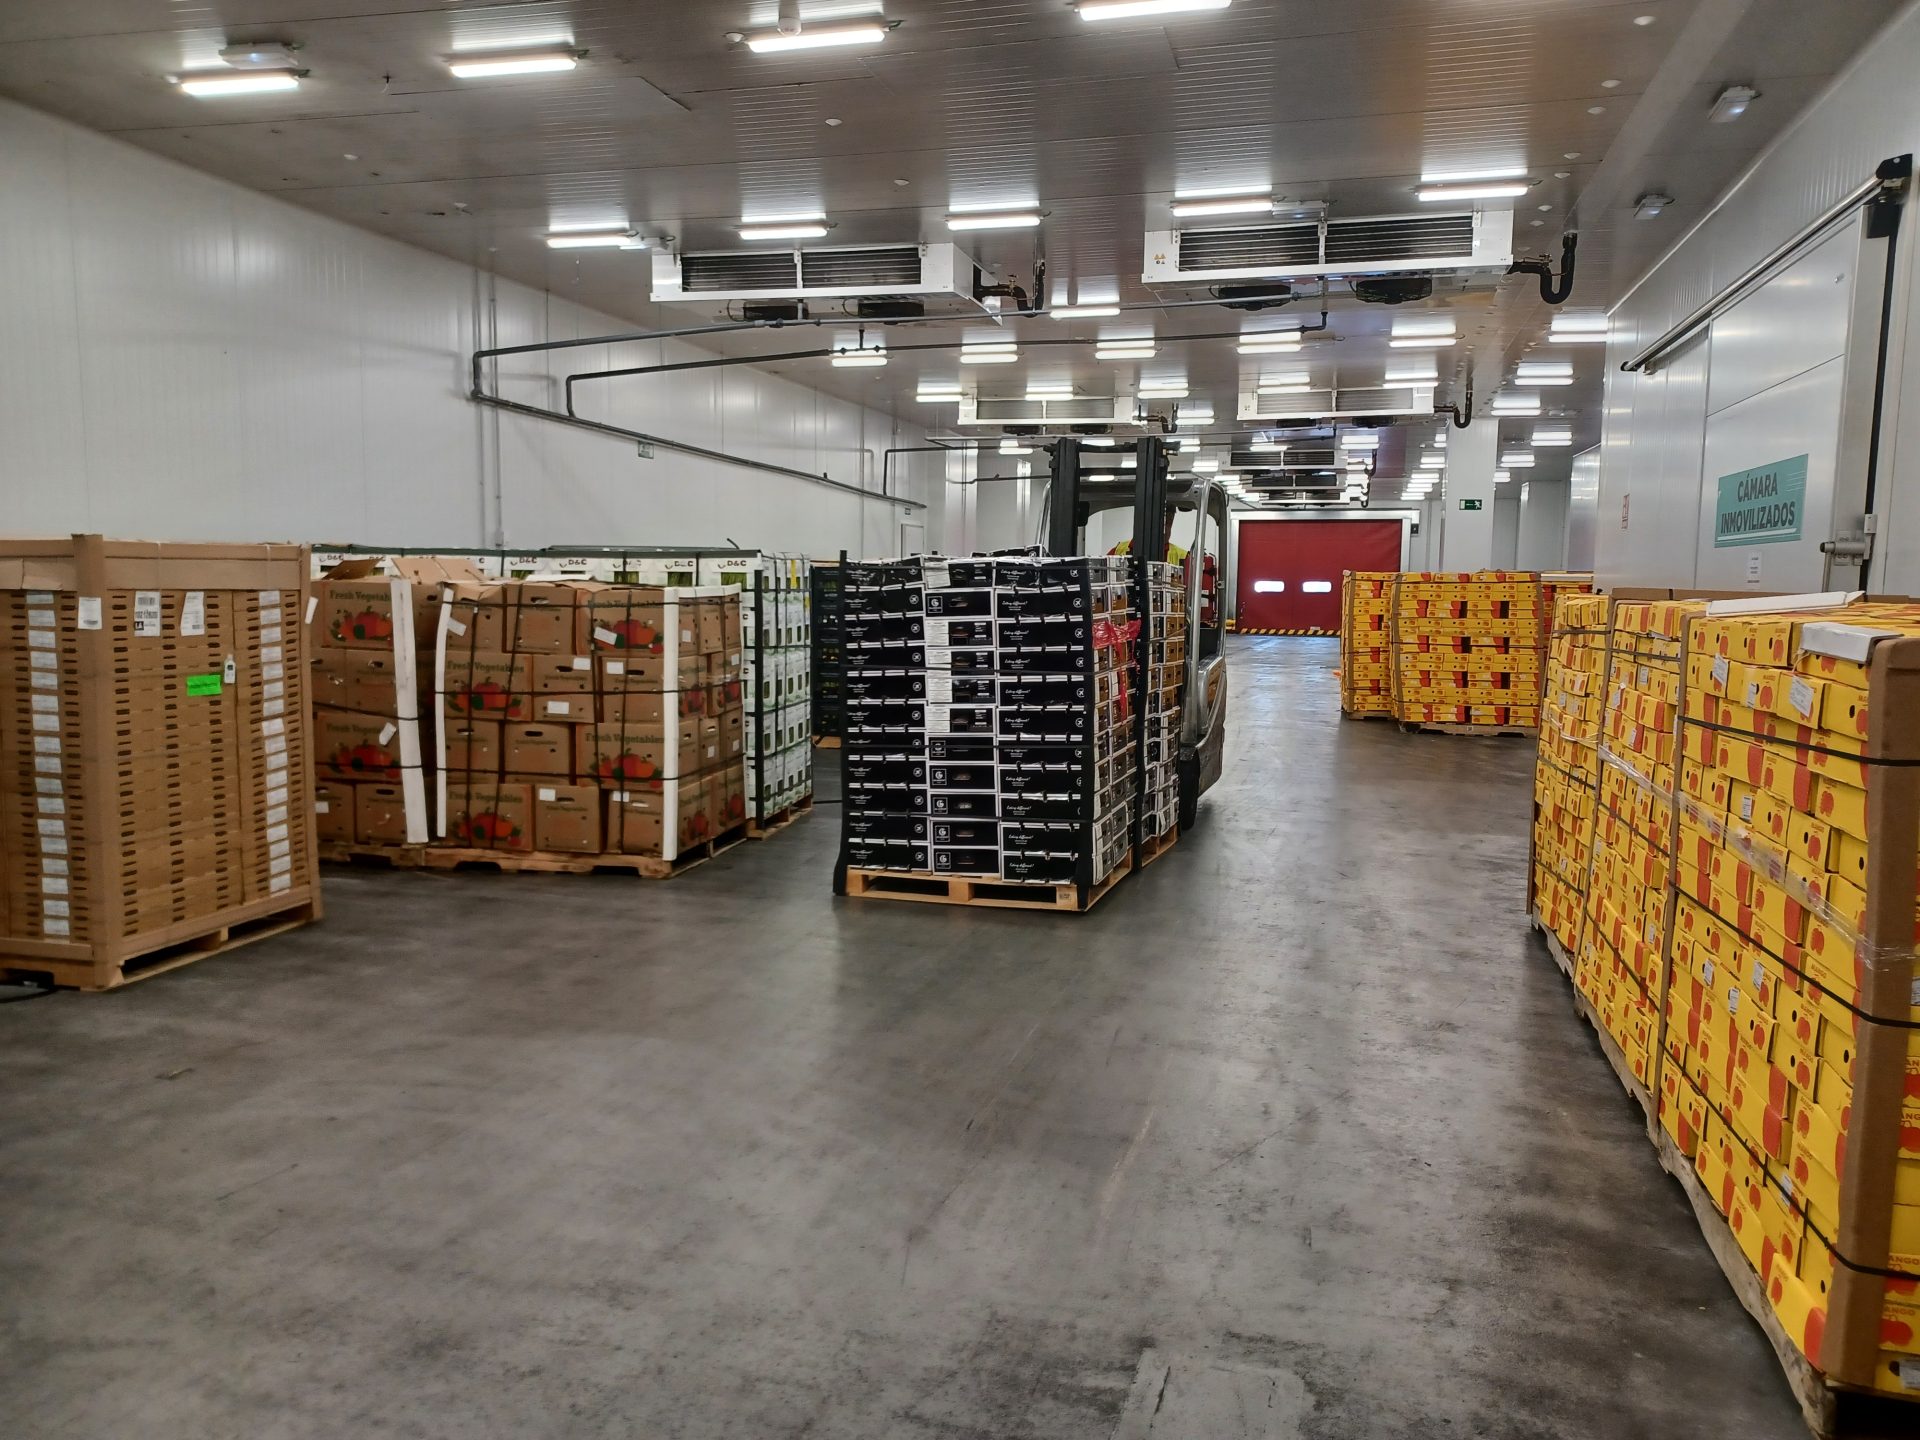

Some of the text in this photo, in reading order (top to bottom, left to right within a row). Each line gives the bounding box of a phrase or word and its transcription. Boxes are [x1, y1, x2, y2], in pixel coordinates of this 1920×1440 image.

[1737, 473, 1778, 502] CÁMARA
[1720, 501, 1795, 534] INMOVILIZADOS
[1890, 1256, 1920, 1266] ANGO
